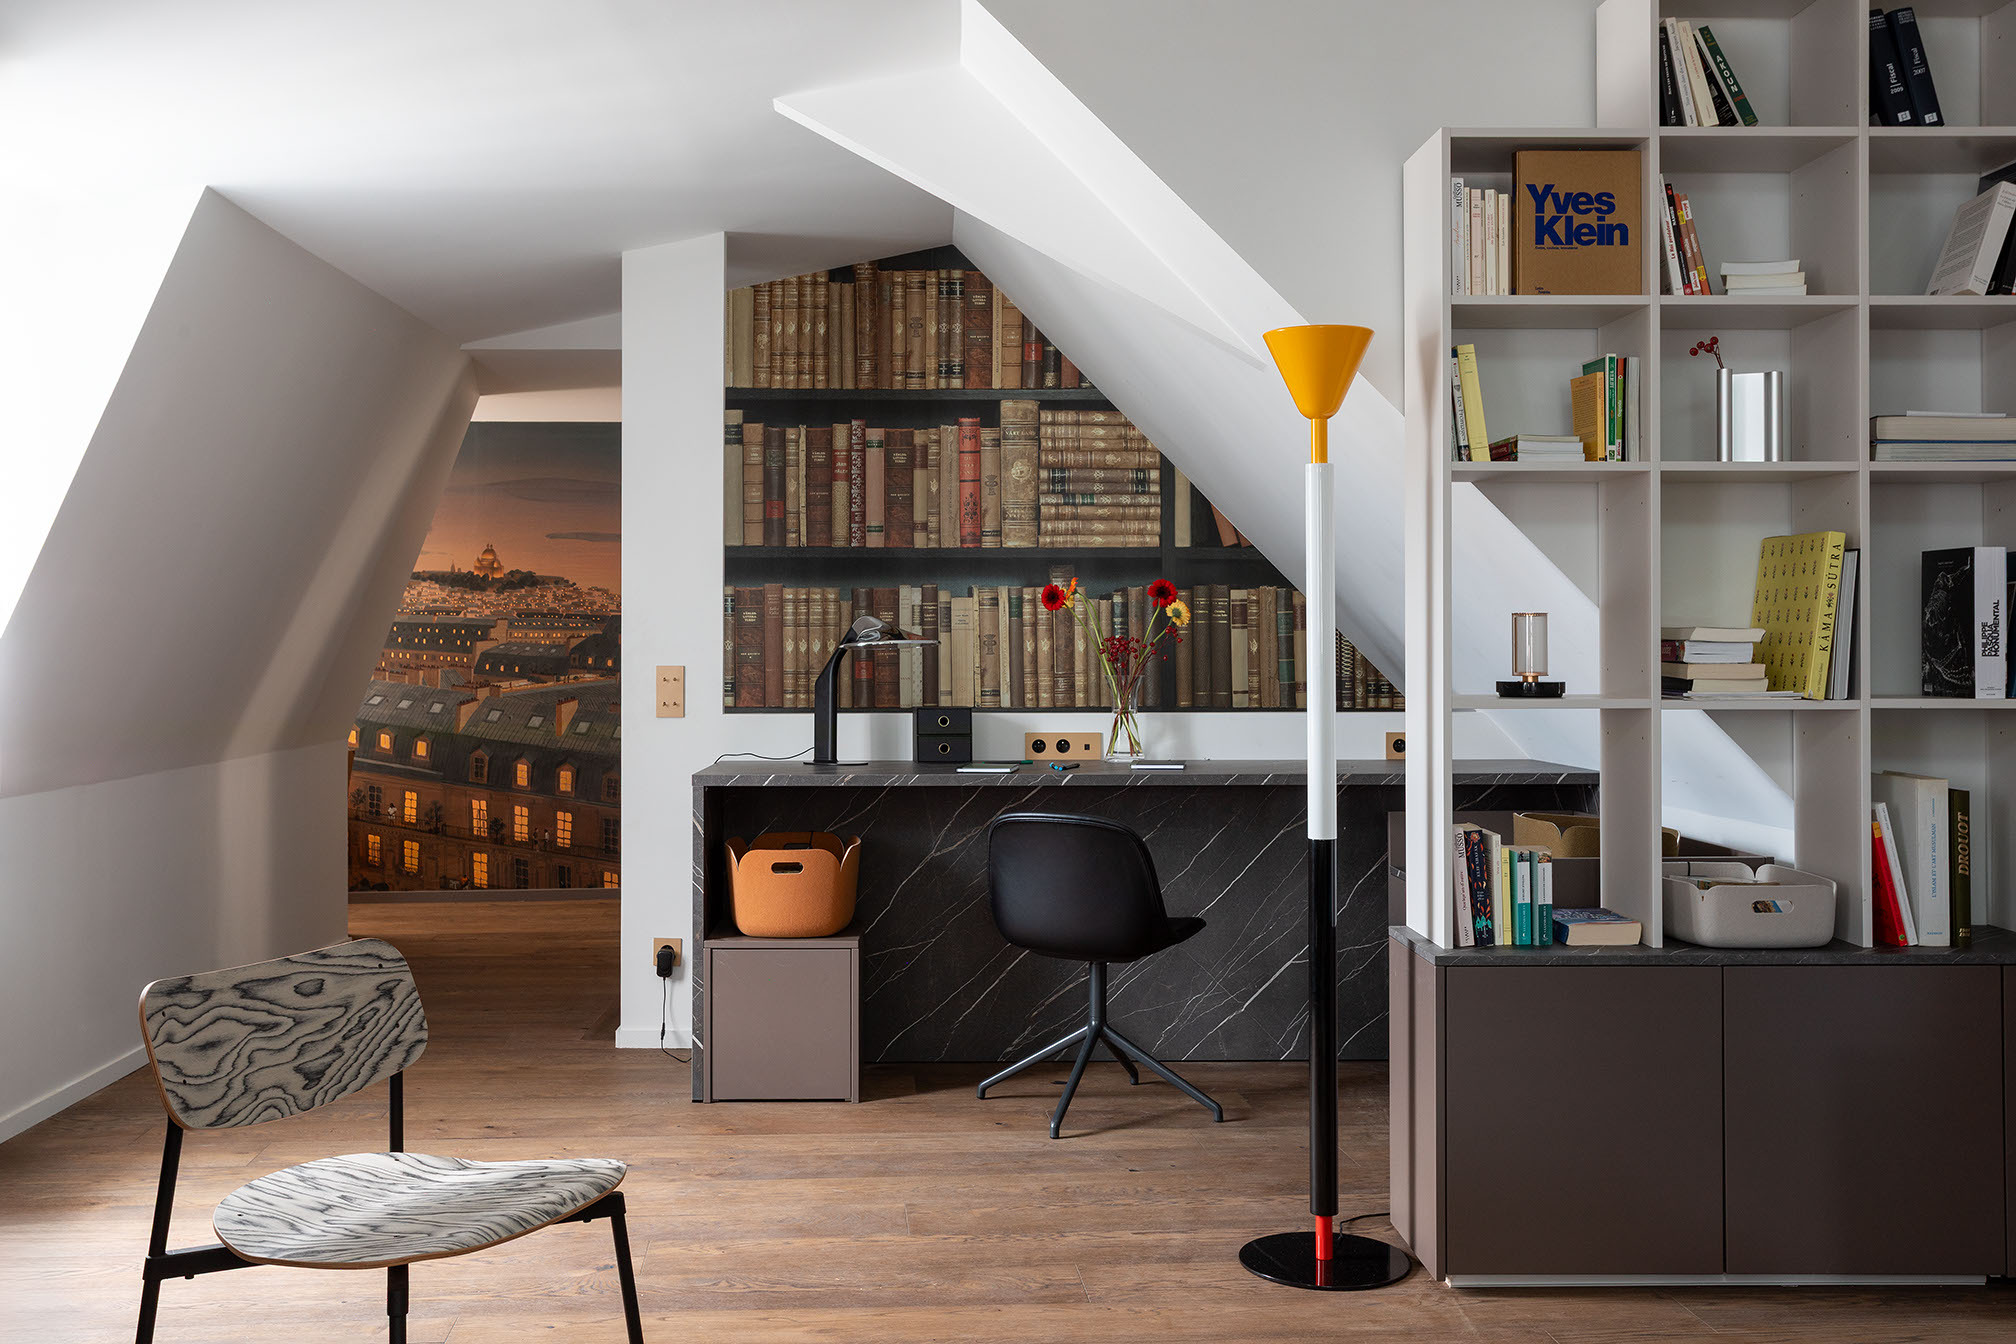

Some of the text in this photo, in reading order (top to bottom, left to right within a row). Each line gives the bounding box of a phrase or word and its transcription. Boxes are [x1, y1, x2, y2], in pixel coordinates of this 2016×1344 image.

[1911, 48, 1921, 64] Fiscal
[1716, 55, 1738, 93] AKOUN
[1886, 63, 1898, 83] Fiscal
[1525, 184, 1616, 215] Yves
[1535, 215, 1629, 246] Klein
[1456, 832, 1464, 858] MUSSO
[1957, 812, 1970, 875] DROUOT
